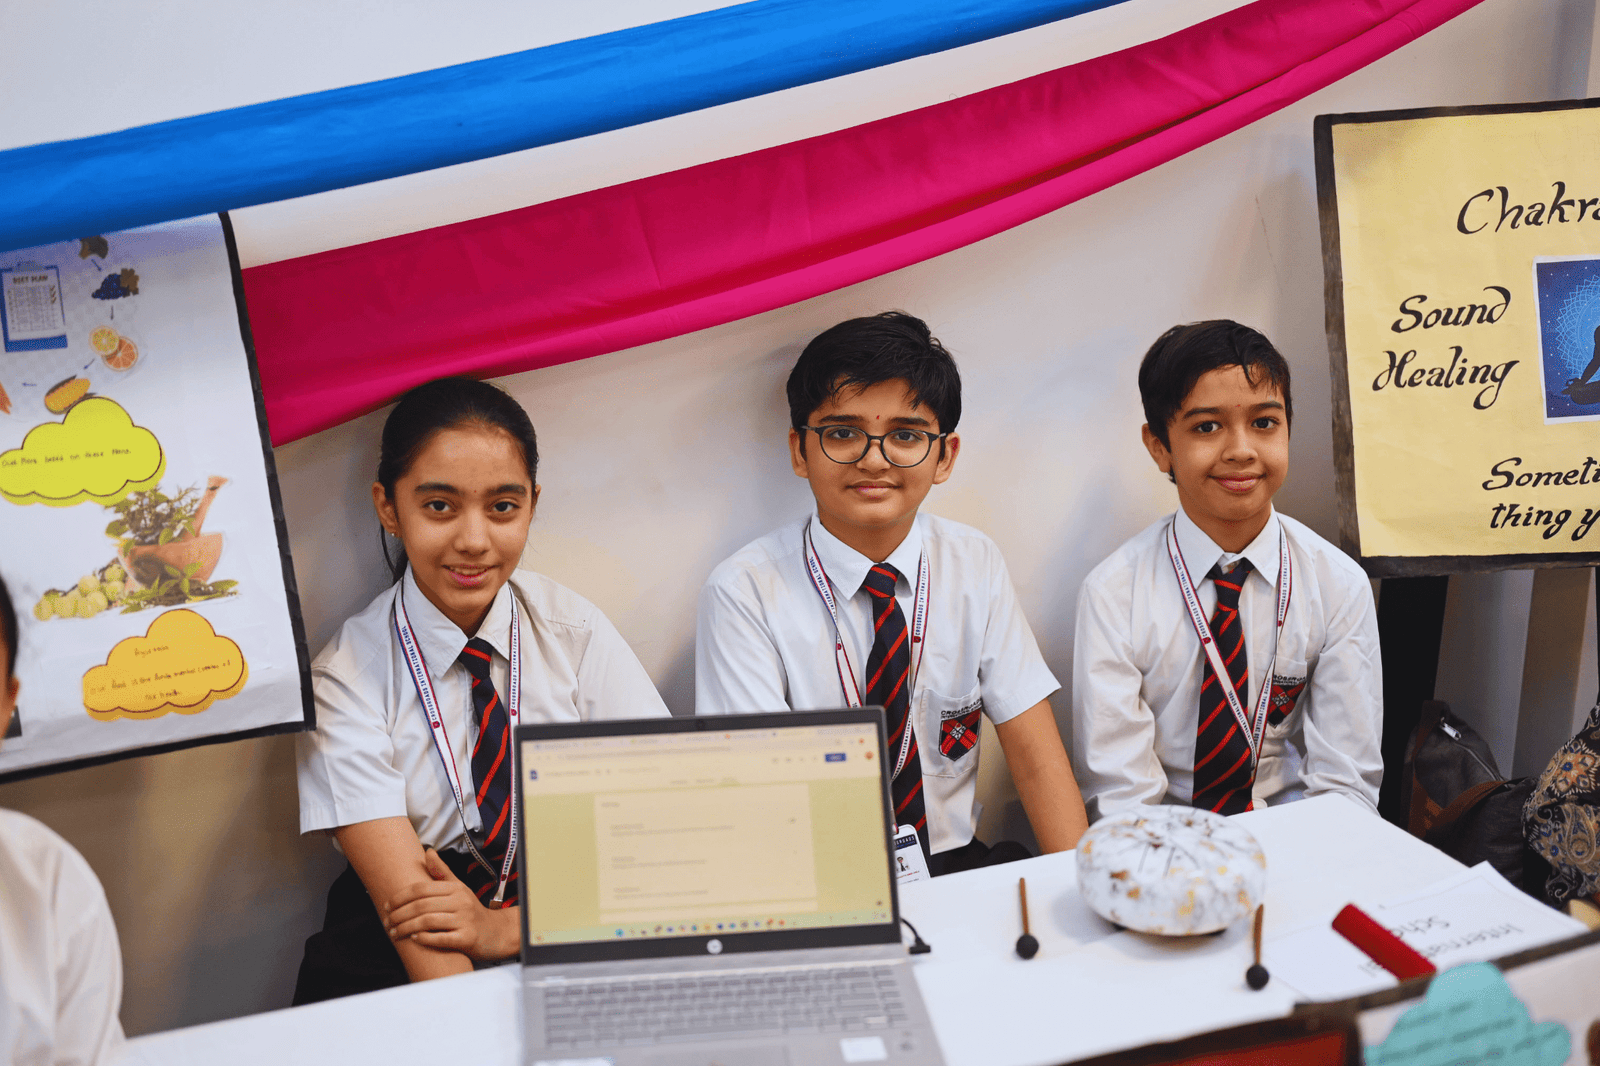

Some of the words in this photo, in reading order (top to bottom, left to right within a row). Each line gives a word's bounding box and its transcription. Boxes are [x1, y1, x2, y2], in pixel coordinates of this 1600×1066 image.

[1391, 286, 1511, 333] Sound
[1372, 345, 1520, 410] Healing
[1490, 503, 1572, 539] thing
[807, 556, 820, 574] SCHOOL
[1178, 570, 1197, 608] INTERNATIONAL
[399, 625, 413, 646] SCHOOL
[915, 604, 924, 636] CROSSROADS
[1192, 607, 1209, 638] CROSSROADS
[406, 645, 427, 687] INTERNATIONAL
[421, 687, 438, 721] CROSSROADS
